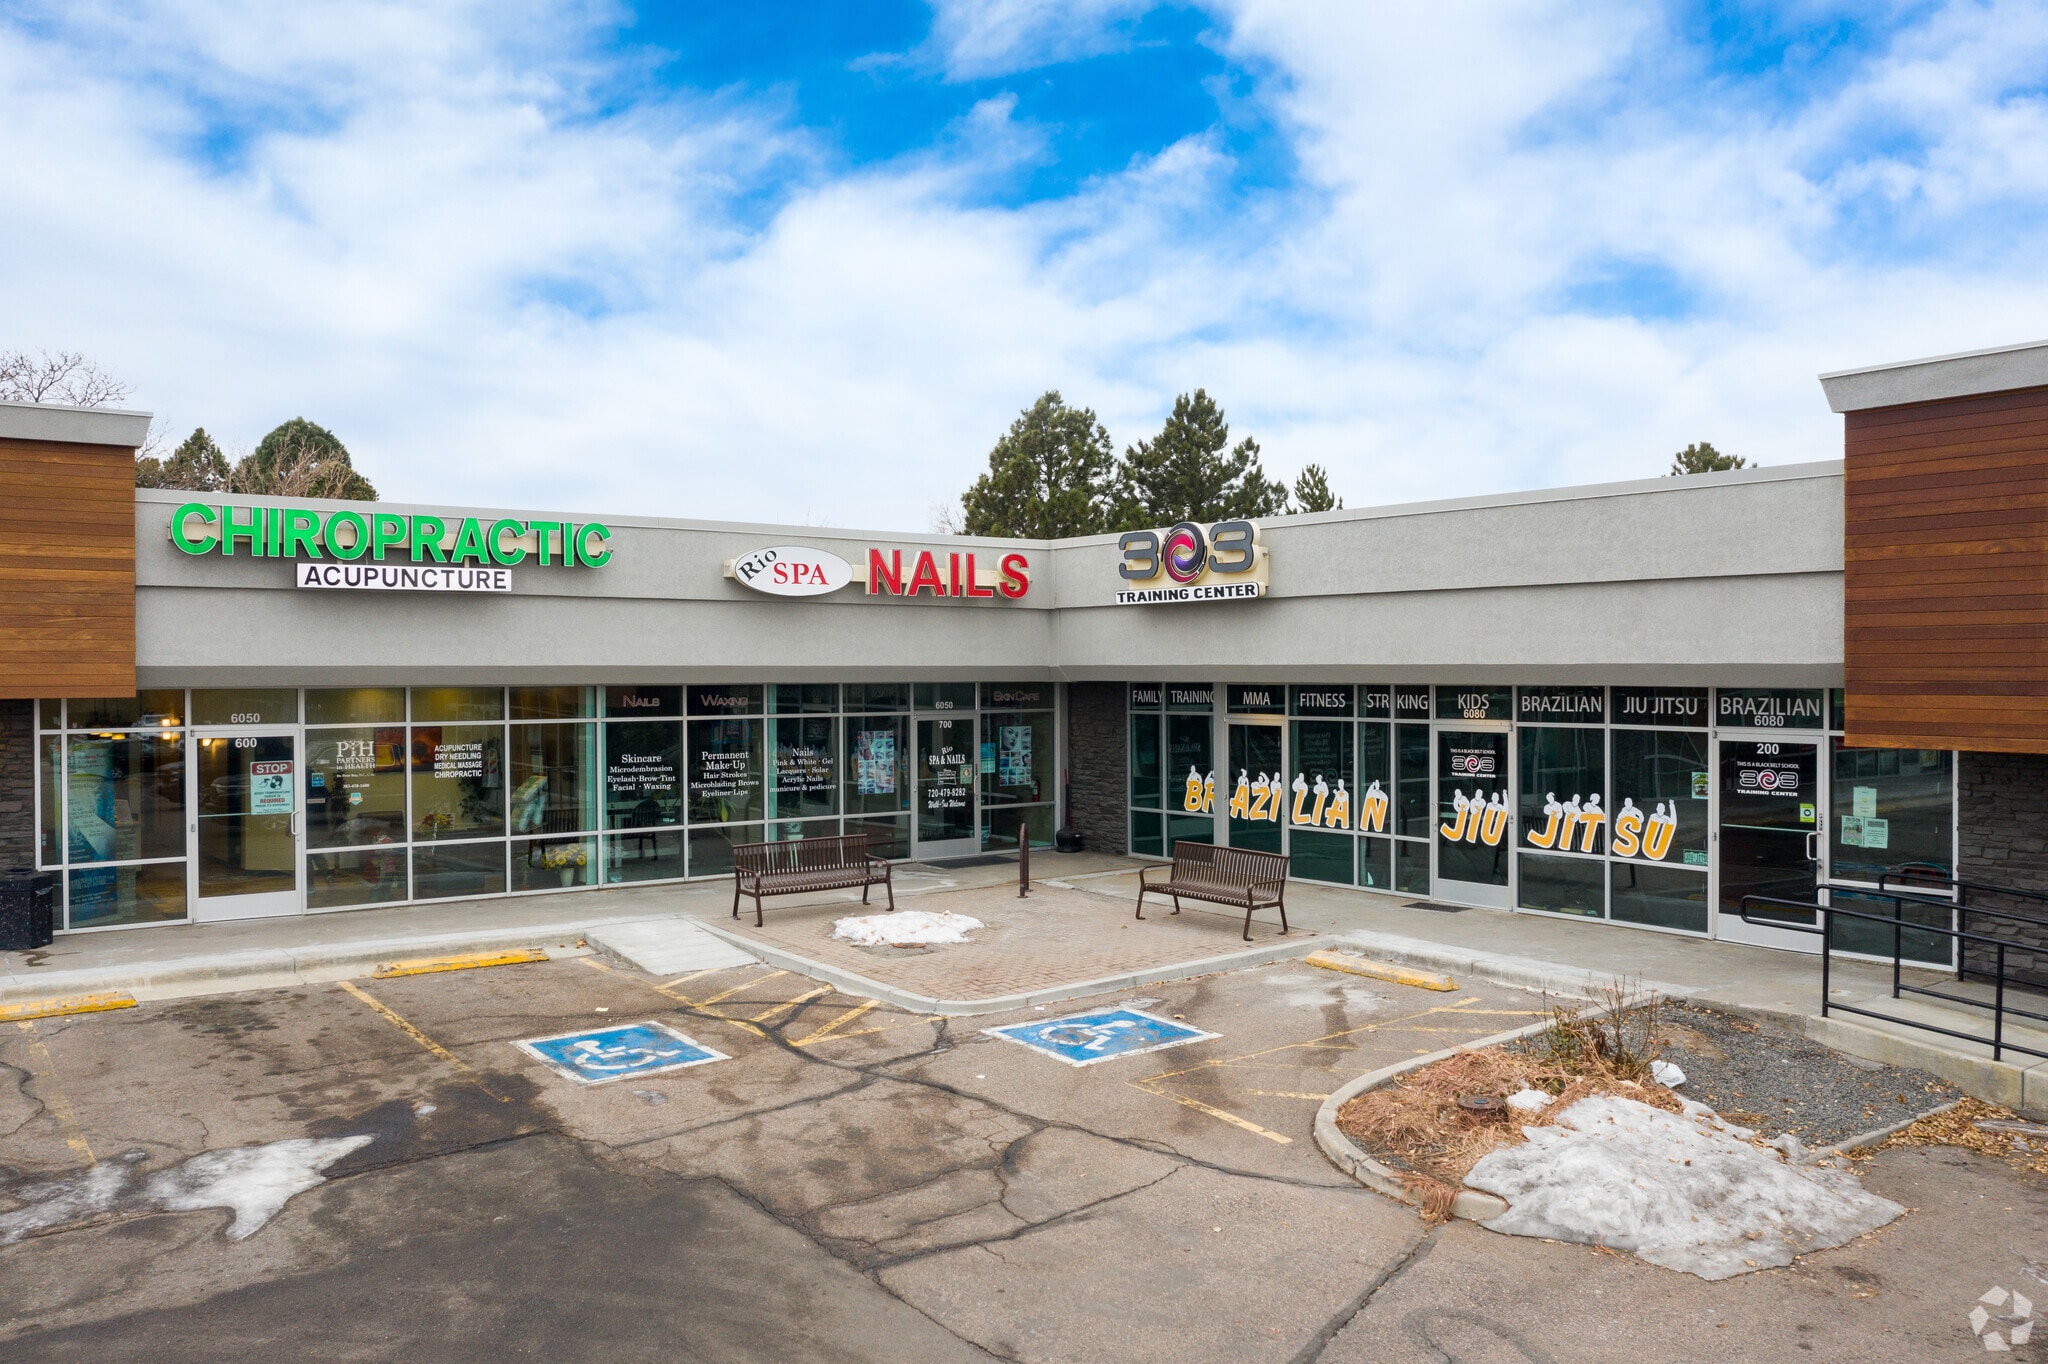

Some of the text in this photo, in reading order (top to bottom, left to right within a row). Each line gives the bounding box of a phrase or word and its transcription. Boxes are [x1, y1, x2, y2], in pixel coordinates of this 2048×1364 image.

[170, 502, 612, 569] CHIROPRACTIC
[1118, 520, 1258, 584] 303
[738, 549, 778, 582] Rio
[304, 565, 507, 590] ACUPUNCTURE
[773, 562, 830, 586] SPA
[868, 547, 1030, 600] NAILS
[1117, 584, 1256, 603] TRAINING CENTER
[1132, 690, 1163, 703] FAMILY
[1243, 692, 1270, 706] MMA
[1300, 693, 1346, 708] FITNESS
[1367, 694, 1428, 710] STRKING
[1458, 694, 1490, 710] KIDS
[936, 701, 954, 710] 6050
[1522, 696, 1602, 713] BRAZILIAN
[1623, 697, 1698, 716] JIU JITSU
[1720, 697, 1820, 717] BRAZILIAN
[230, 713, 260, 724] 6050
[1464, 708, 1486, 719] 6080
[939, 720, 952, 728] 700
[1754, 716, 1784, 726] 6080
[235, 738, 258, 748] 600
[792, 748, 814, 757] Nails
[941, 746, 953, 754] Rio
[1756, 744, 1780, 754] 200
[621, 754, 662, 764] Skincare
[702, 751, 749, 760] Permanent
[929, 754, 966, 765] SPA & NAILS
[256, 764, 288, 774] STOP
[609, 765, 673, 773] Microdembrasion
[1452, 755, 1494, 772] 303
[434, 770, 482, 778] CHIROPRACTIC
[776, 767, 806, 776] Lacquers
[691, 781, 736, 789] Microblading
[782, 776, 804, 784] Acrylic
[1740, 769, 1798, 790] 303
[809, 783, 836, 792] pedicure
[1184, 780, 1677, 860] BRAZILIAN JIU JITSU
